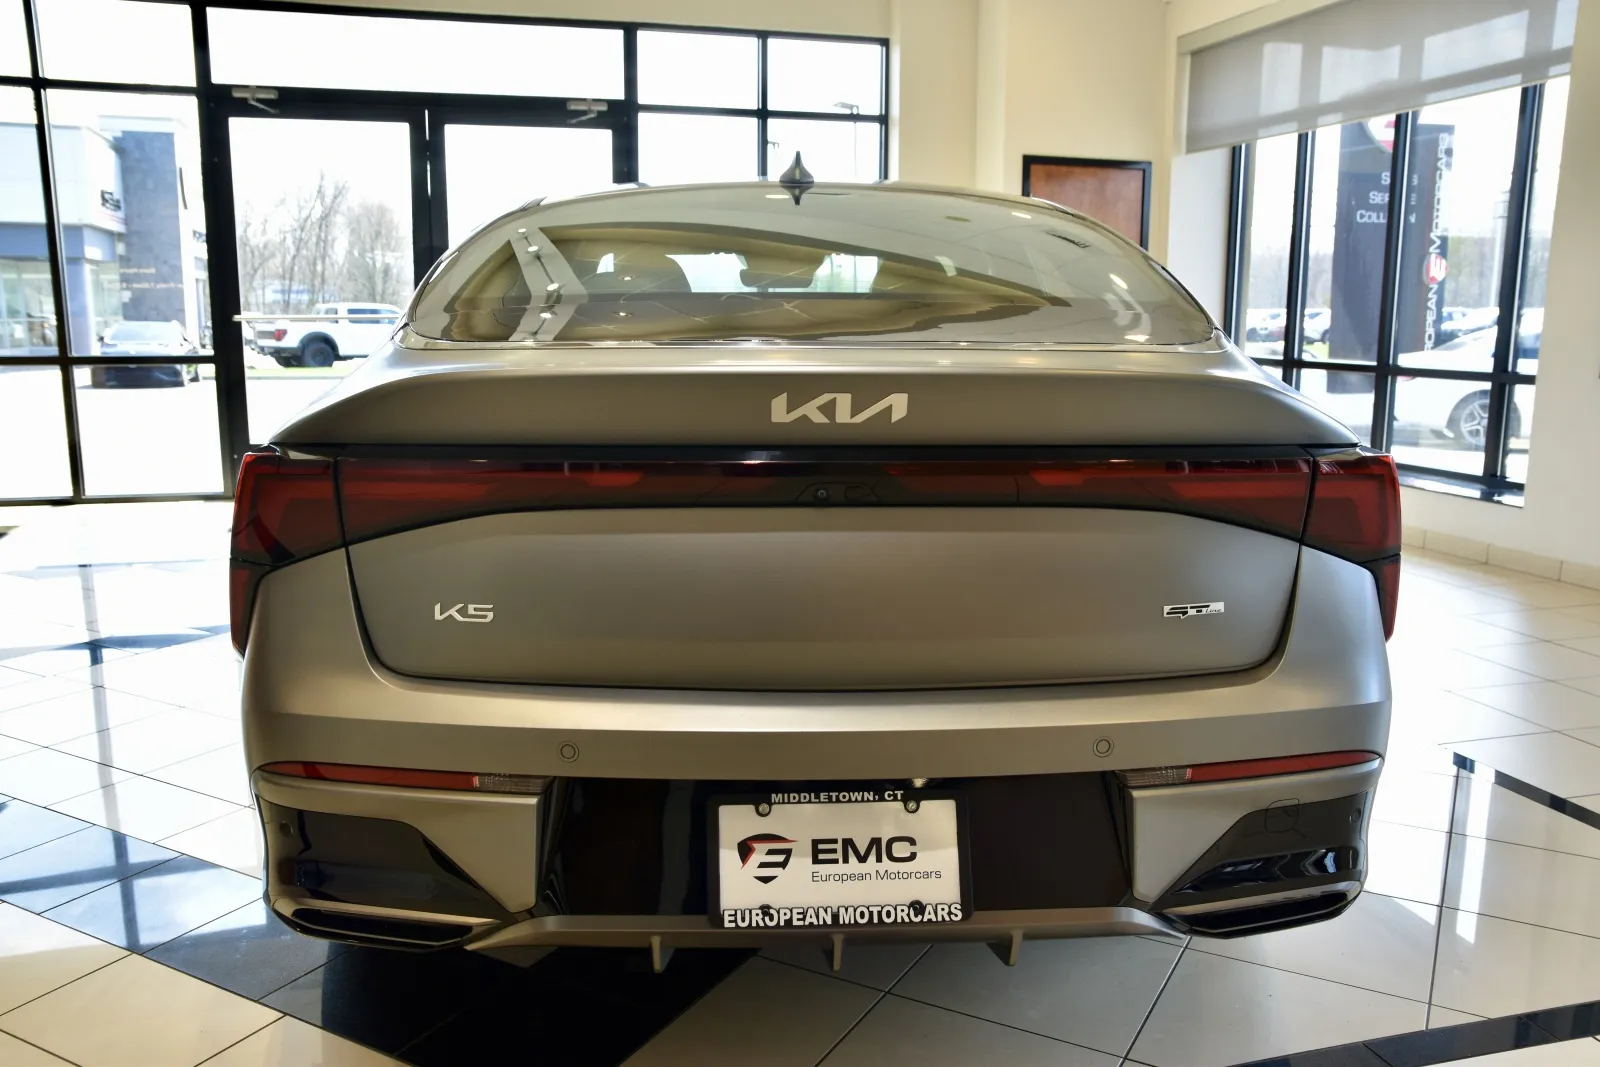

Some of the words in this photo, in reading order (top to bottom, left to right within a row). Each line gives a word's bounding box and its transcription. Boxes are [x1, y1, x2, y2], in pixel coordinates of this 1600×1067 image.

[1424, 284, 1438, 351] ROPEAN
[771, 392, 909, 424] KIA
[434, 602, 494, 623] K5
[771, 791, 879, 804] MIDDLETOWN,
[884, 790, 904, 801] CT
[811, 836, 918, 865] EMC
[811, 871, 872, 884] European
[876, 869, 942, 881] Motorcars
[724, 906, 832, 928] EUROPEAN
[838, 903, 963, 924] MOTORCARS
